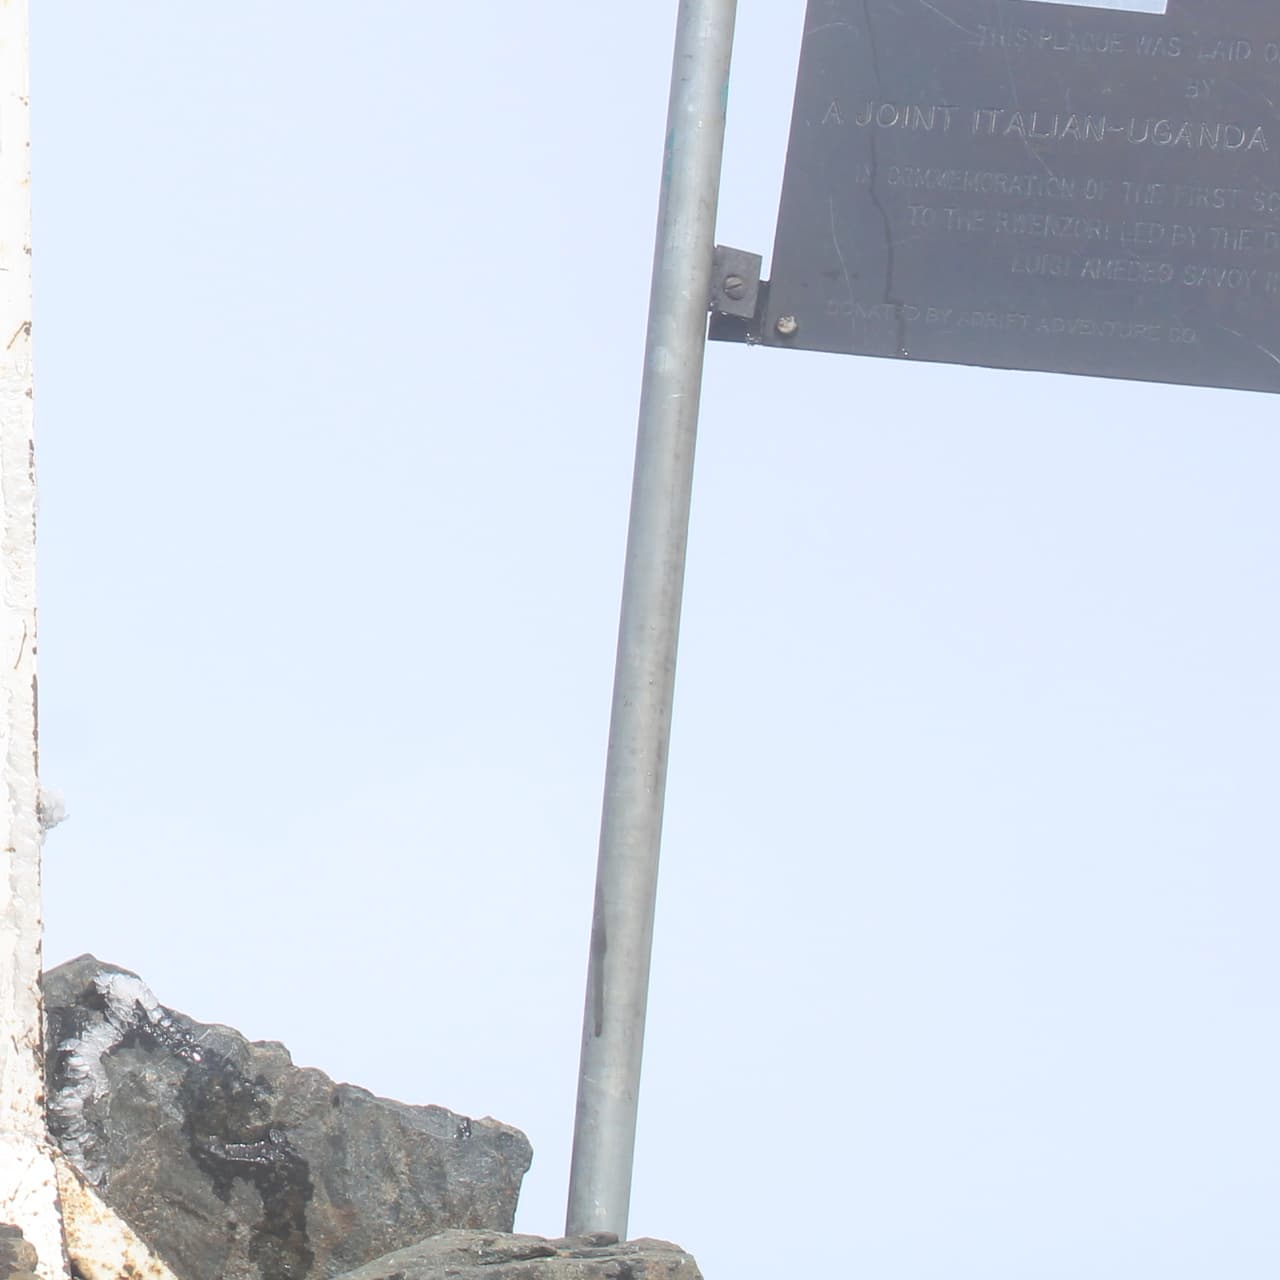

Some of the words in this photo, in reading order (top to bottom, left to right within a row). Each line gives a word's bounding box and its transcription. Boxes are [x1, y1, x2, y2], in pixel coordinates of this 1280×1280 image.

[1039, 27, 1127, 55] PLAQUE
[1136, 33, 1182, 58] WAS
[1196, 39, 1253, 63] LAID
[822, 99, 844, 126] A
[855, 100, 961, 133] JOINT
[971, 106, 1271, 153] ITALIAN-UGANDA
[886, 166, 1077, 202] COMMEMORATION
[1084, 178, 1113, 202] OF
[1122, 180, 1163, 207] THE
[1174, 183, 1242, 210] FIRST
[908, 203, 936, 227] TO
[942, 204, 985, 232] THE
[1120, 218, 1165, 247] LED
[1172, 222, 1198, 248] BY
[1209, 225, 1254, 252] THE
[1011, 255, 1071, 279] LUIGI
[1080, 258, 1175, 285] AMEDEO
[1182, 262, 1257, 291] SAVOY
[926, 306, 954, 324] BY
[1036, 315, 1162, 342] ADVENTURE
